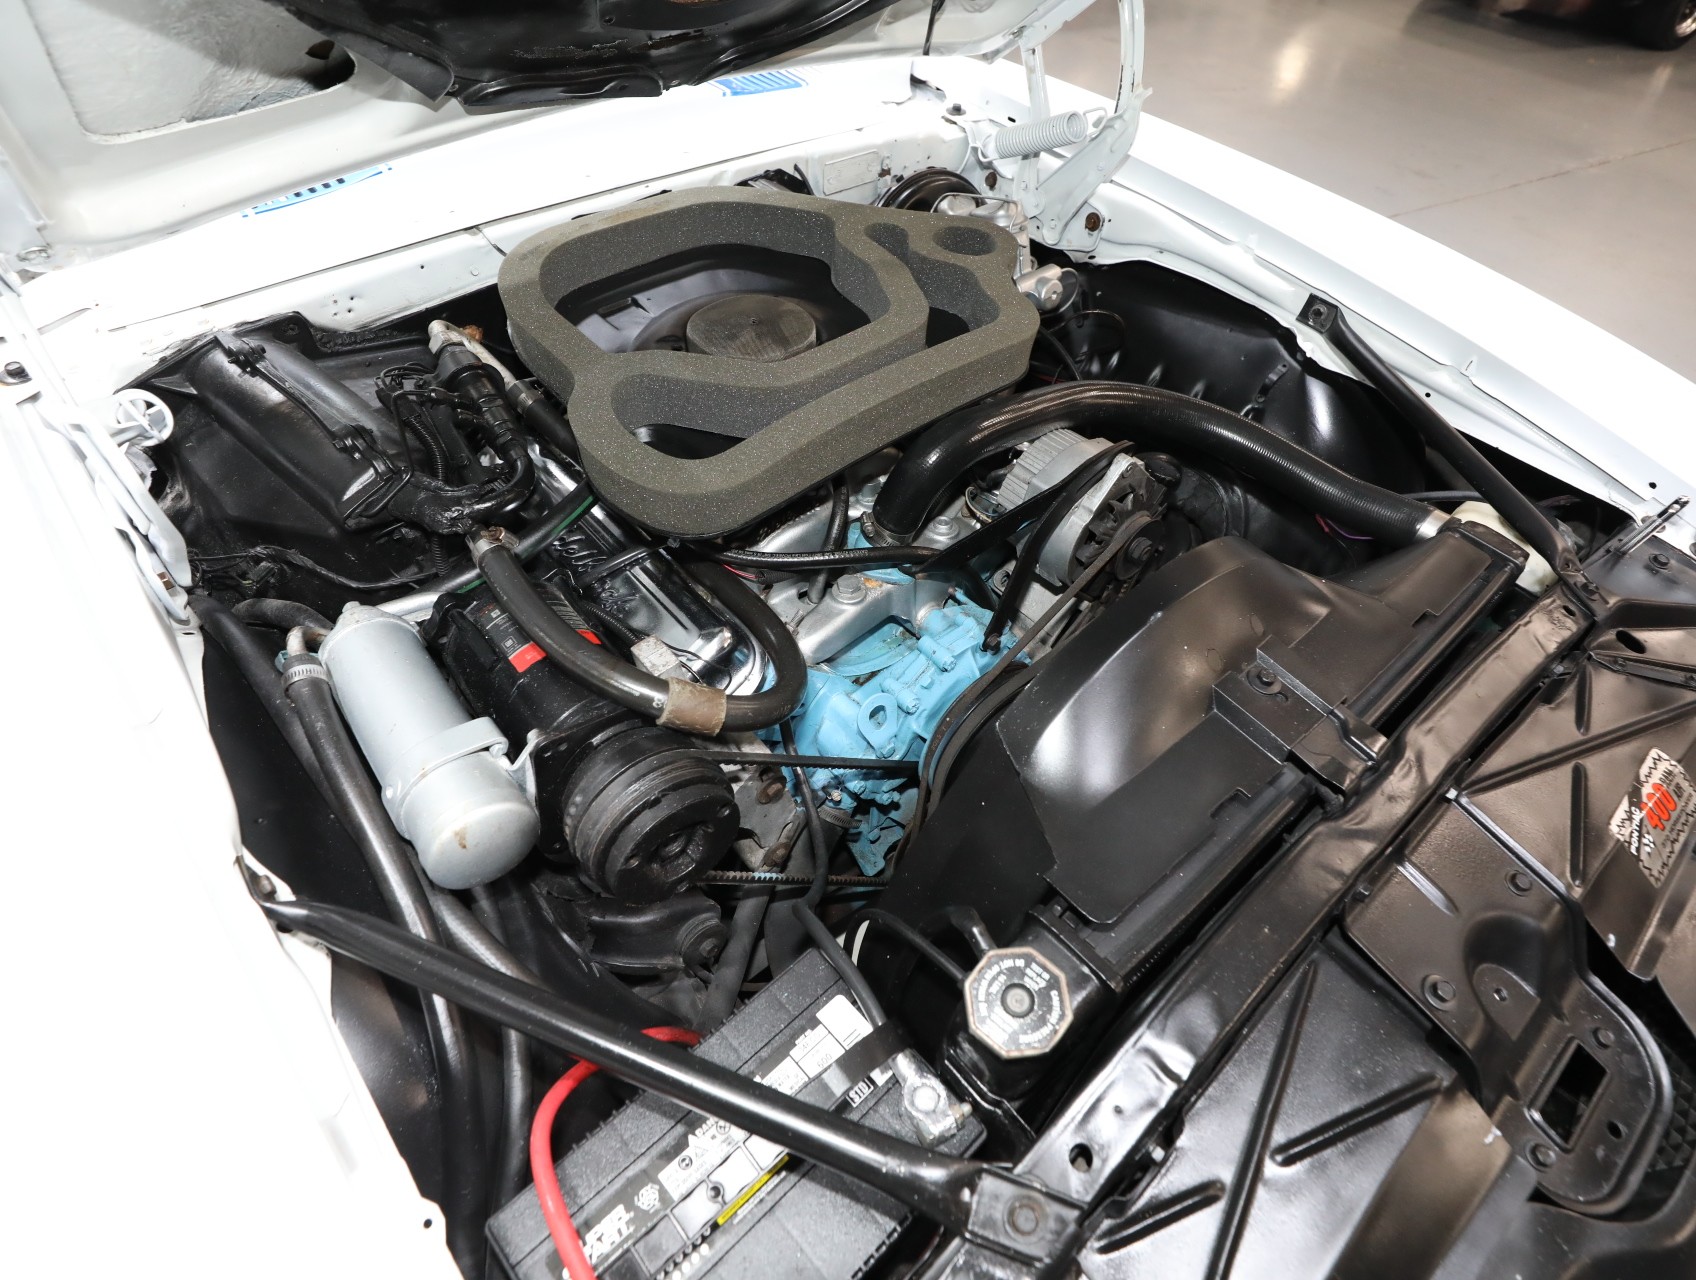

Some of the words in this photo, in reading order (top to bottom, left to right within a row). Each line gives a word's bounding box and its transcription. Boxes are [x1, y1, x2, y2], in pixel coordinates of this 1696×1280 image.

[1630, 806, 1642, 855] PONTIAC
[1640, 782, 1677, 831] 400
[848, 1081, 869, 1103] STD
